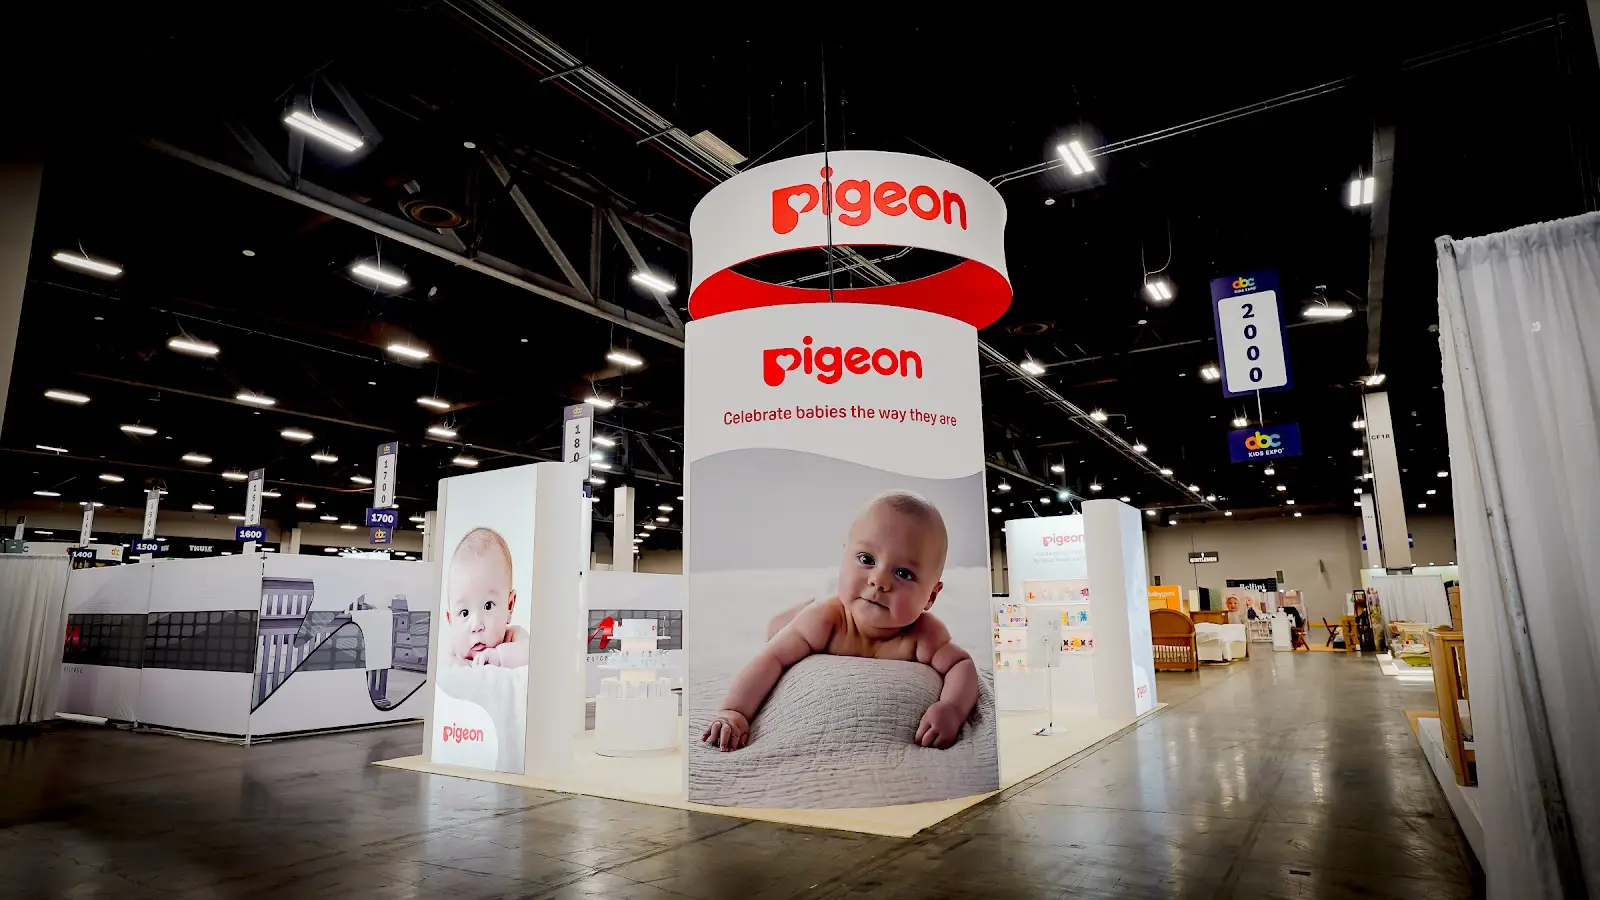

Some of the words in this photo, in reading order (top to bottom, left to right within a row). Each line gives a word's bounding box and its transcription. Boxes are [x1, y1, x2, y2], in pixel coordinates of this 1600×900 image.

[772, 166, 967, 234] pigeon
[1232, 277, 1255, 289] abc
[763, 336, 922, 387] pigeon
[723, 407, 792, 425] Celebrate
[796, 404, 847, 420] babies
[850, 405, 875, 419] the
[878, 408, 906, 423] way
[909, 408, 937, 426] they
[939, 415, 957, 427] are
[1245, 431, 1281, 450] abc
[371, 513, 394, 524] 1700
[239, 529, 262, 539] 1600
[136, 543, 158, 551] 1500
[443, 722, 484, 744] pigeon
